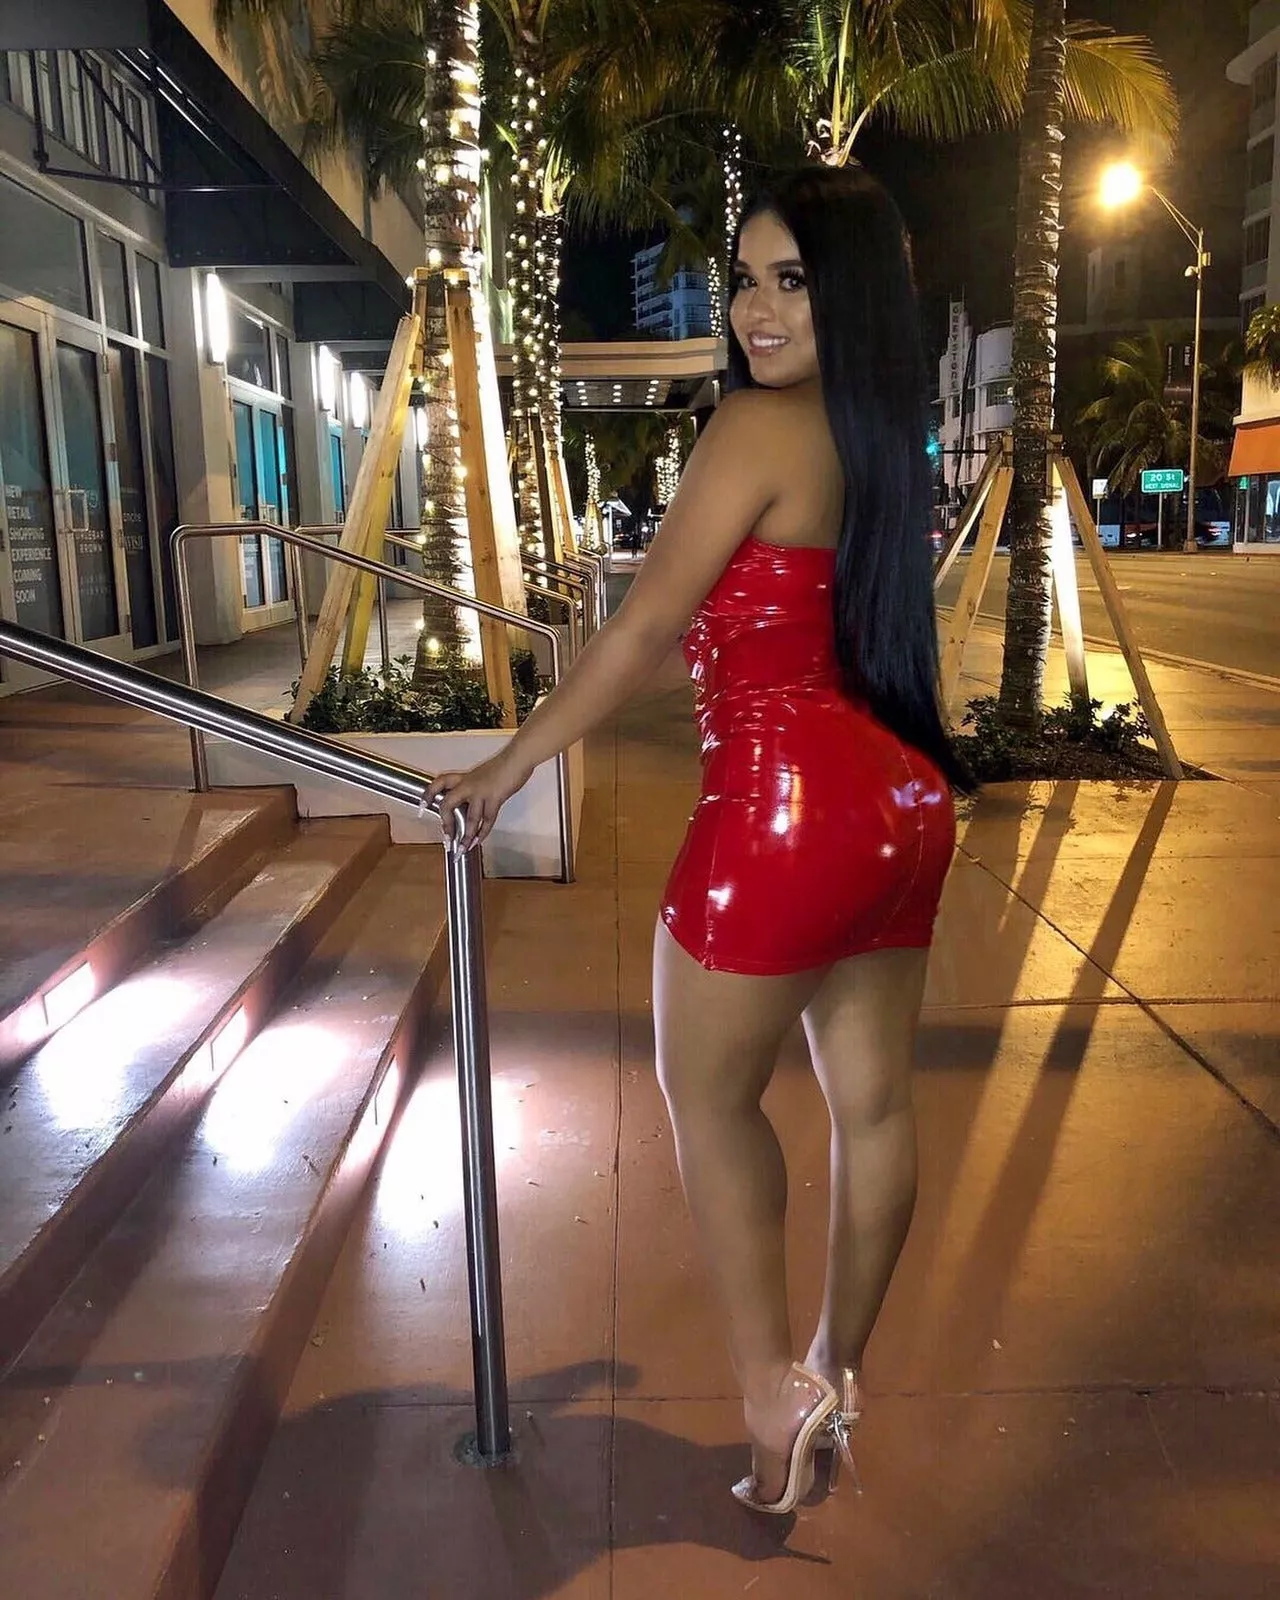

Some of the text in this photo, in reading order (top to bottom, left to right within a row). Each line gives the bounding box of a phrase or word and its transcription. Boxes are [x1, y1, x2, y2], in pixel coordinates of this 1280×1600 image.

[1150, 472, 1176, 482] 20 St
[7, 506, 31, 520] RETAIL
[9, 527, 45, 541] SHOPPING
[11, 547, 52, 561] EXPERIENCE
[14, 568, 42, 581] COMING
[15, 589, 36, 604] SOON
